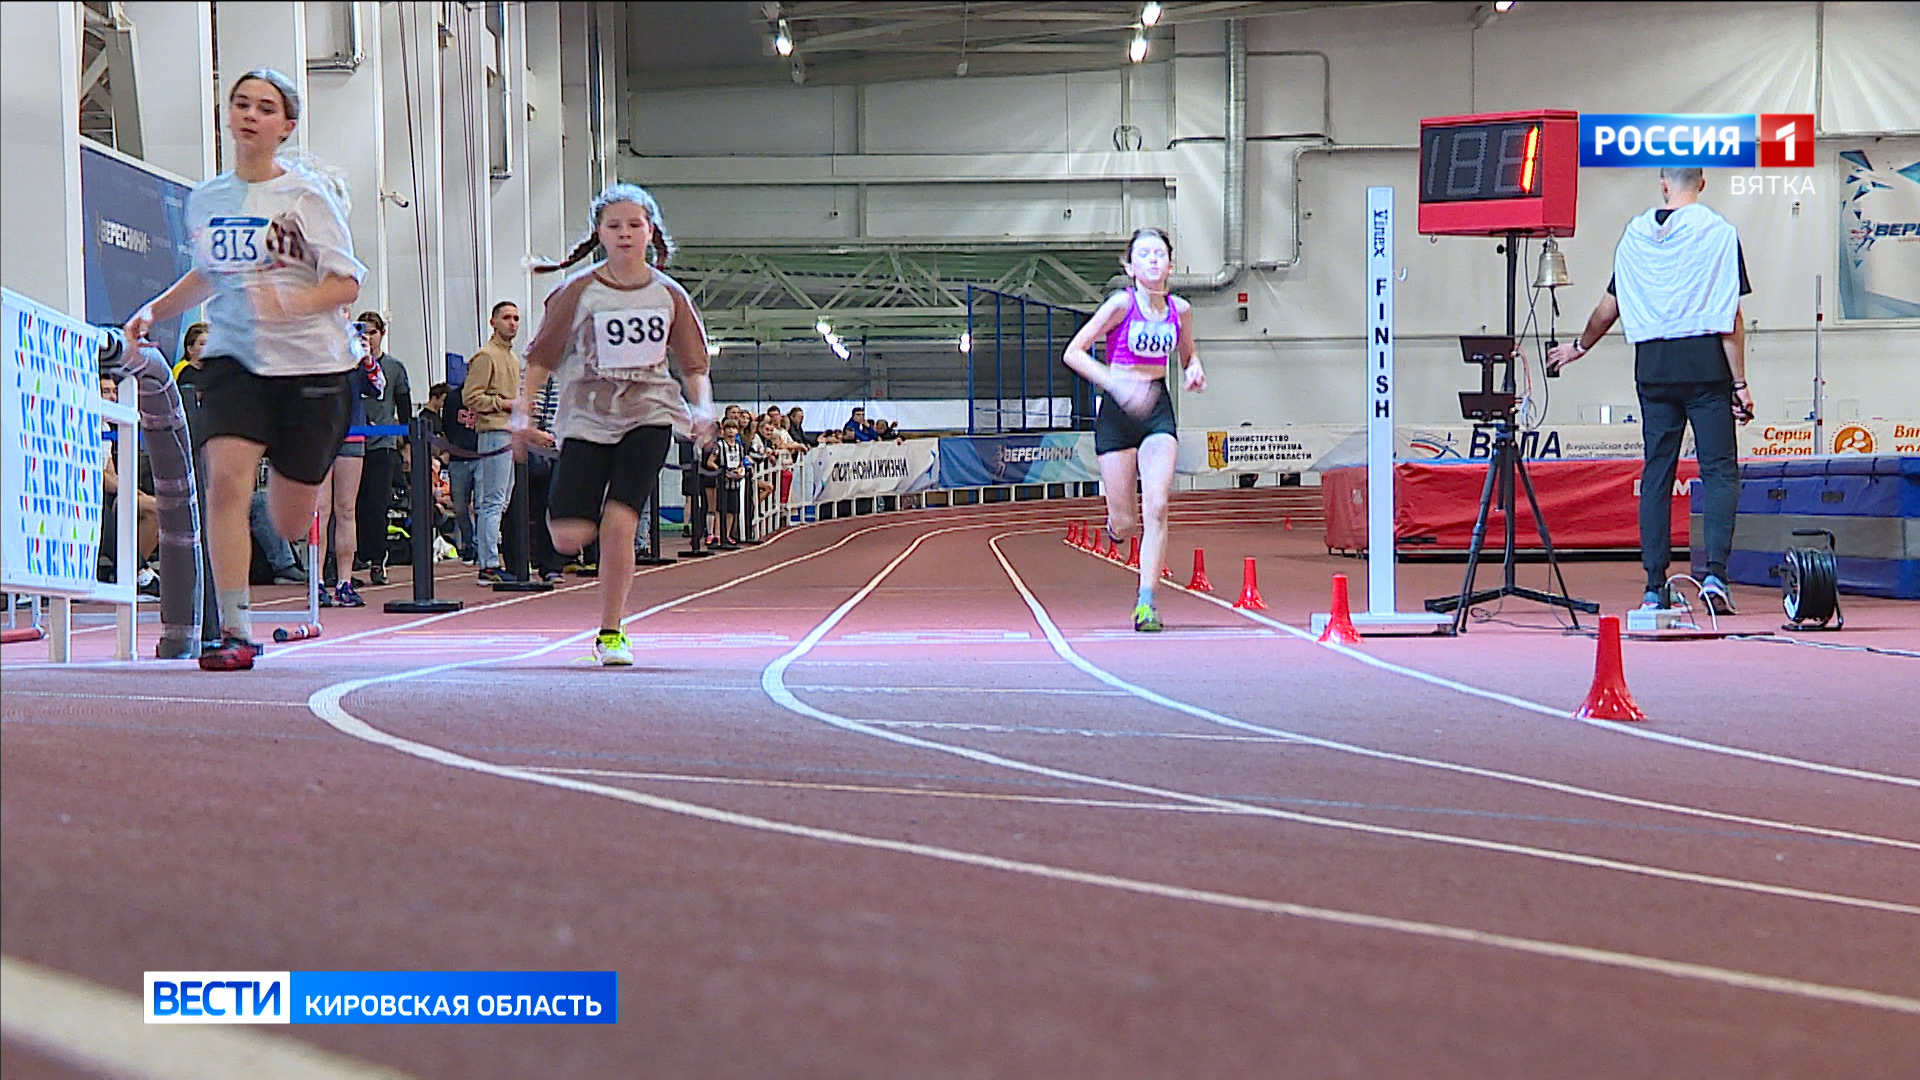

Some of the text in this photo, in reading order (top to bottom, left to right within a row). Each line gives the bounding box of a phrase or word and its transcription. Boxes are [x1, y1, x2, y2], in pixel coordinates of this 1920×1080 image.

[210, 229, 258, 261] 813
[607, 315, 665, 346] 938
[1135, 331, 1173, 354] 888
[1375, 278, 1390, 418] FINISH
[1268, 443, 1303, 451] ТУРИЗМА
[1469, 431, 1562, 459] ВЛА
[1763, 427, 1812, 443] Серия
